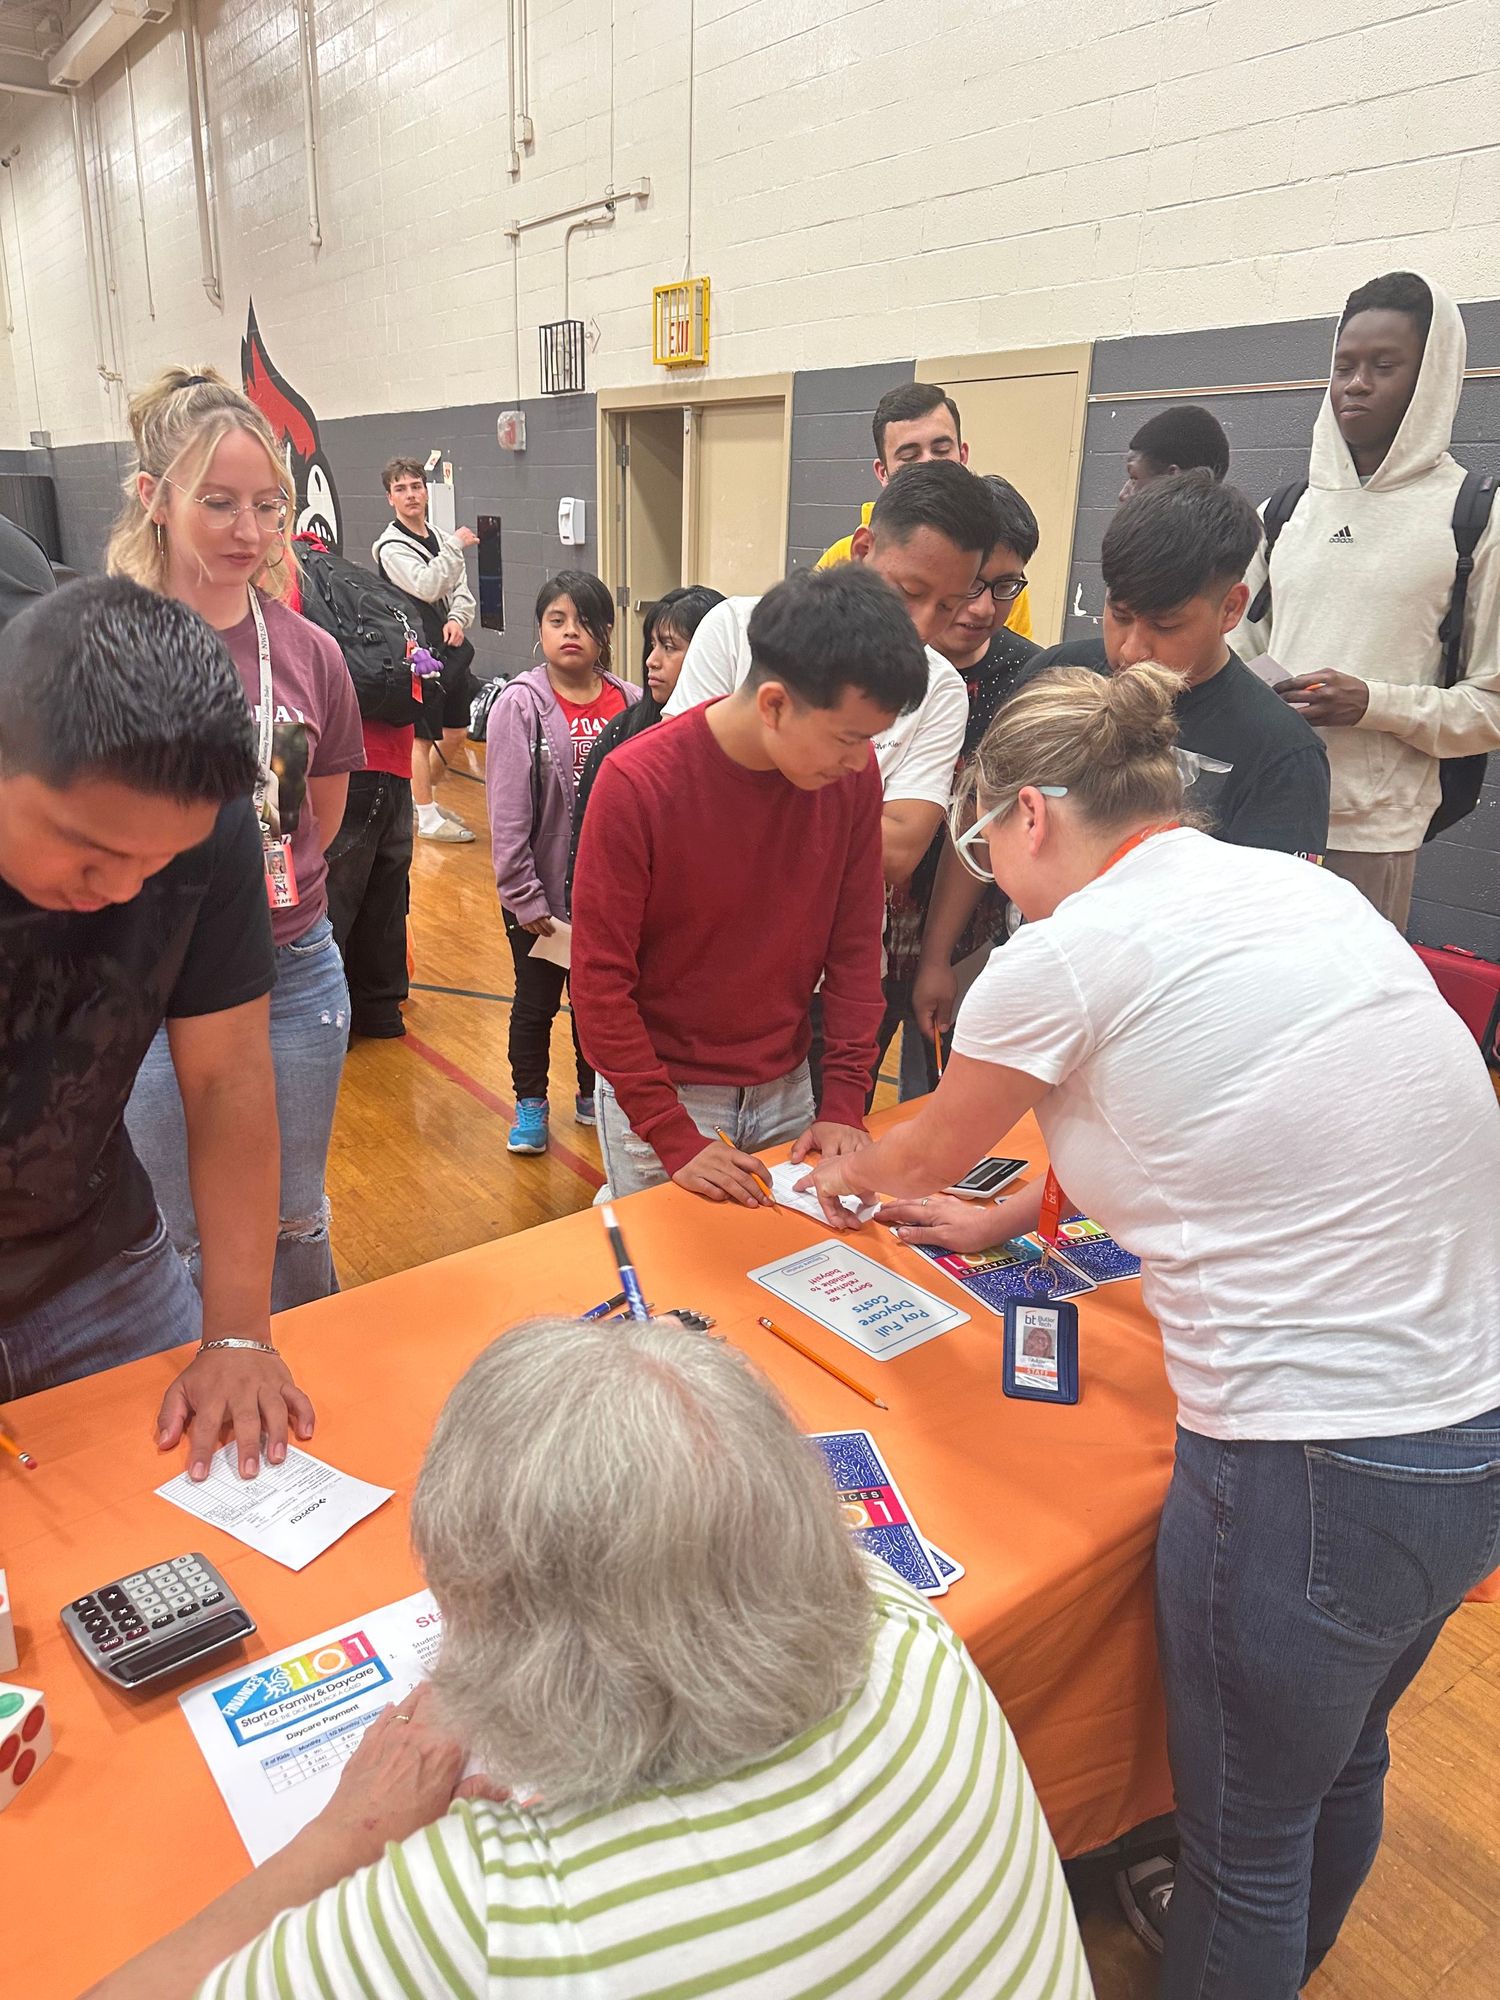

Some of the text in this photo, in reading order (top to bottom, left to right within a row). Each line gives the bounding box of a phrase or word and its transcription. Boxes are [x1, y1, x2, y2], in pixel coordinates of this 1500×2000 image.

[669, 320, 690, 354] EXIT
[272, 897, 293, 905] STAFF
[1060, 1232, 1110, 1246] INANCES
[961, 1256, 1019, 1276] FINANCES
[821, 1271, 855, 1287] available
[825, 1279, 859, 1295] relatives
[849, 1282, 873, 1294] Sorry
[852, 1295, 889, 1313] Costs
[858, 1300, 915, 1326] Daycare
[1025, 1314, 1037, 1325] bt
[1037, 1315, 1055, 1323] Butler
[874, 1309, 930, 1338] Pay Full
[1027, 1368, 1049, 1376] STAFF
[837, 1490, 881, 1502] NCES
[412, 1633, 442, 1649] Student
[222, 1674, 265, 1717] FINANCES
[241, 1667, 374, 1729] Start a Family & Daycare
[286, 1719, 321, 1741] Daycare
[322, 1703, 360, 1724] Payment
[298, 1738, 321, 1751] Monthly
